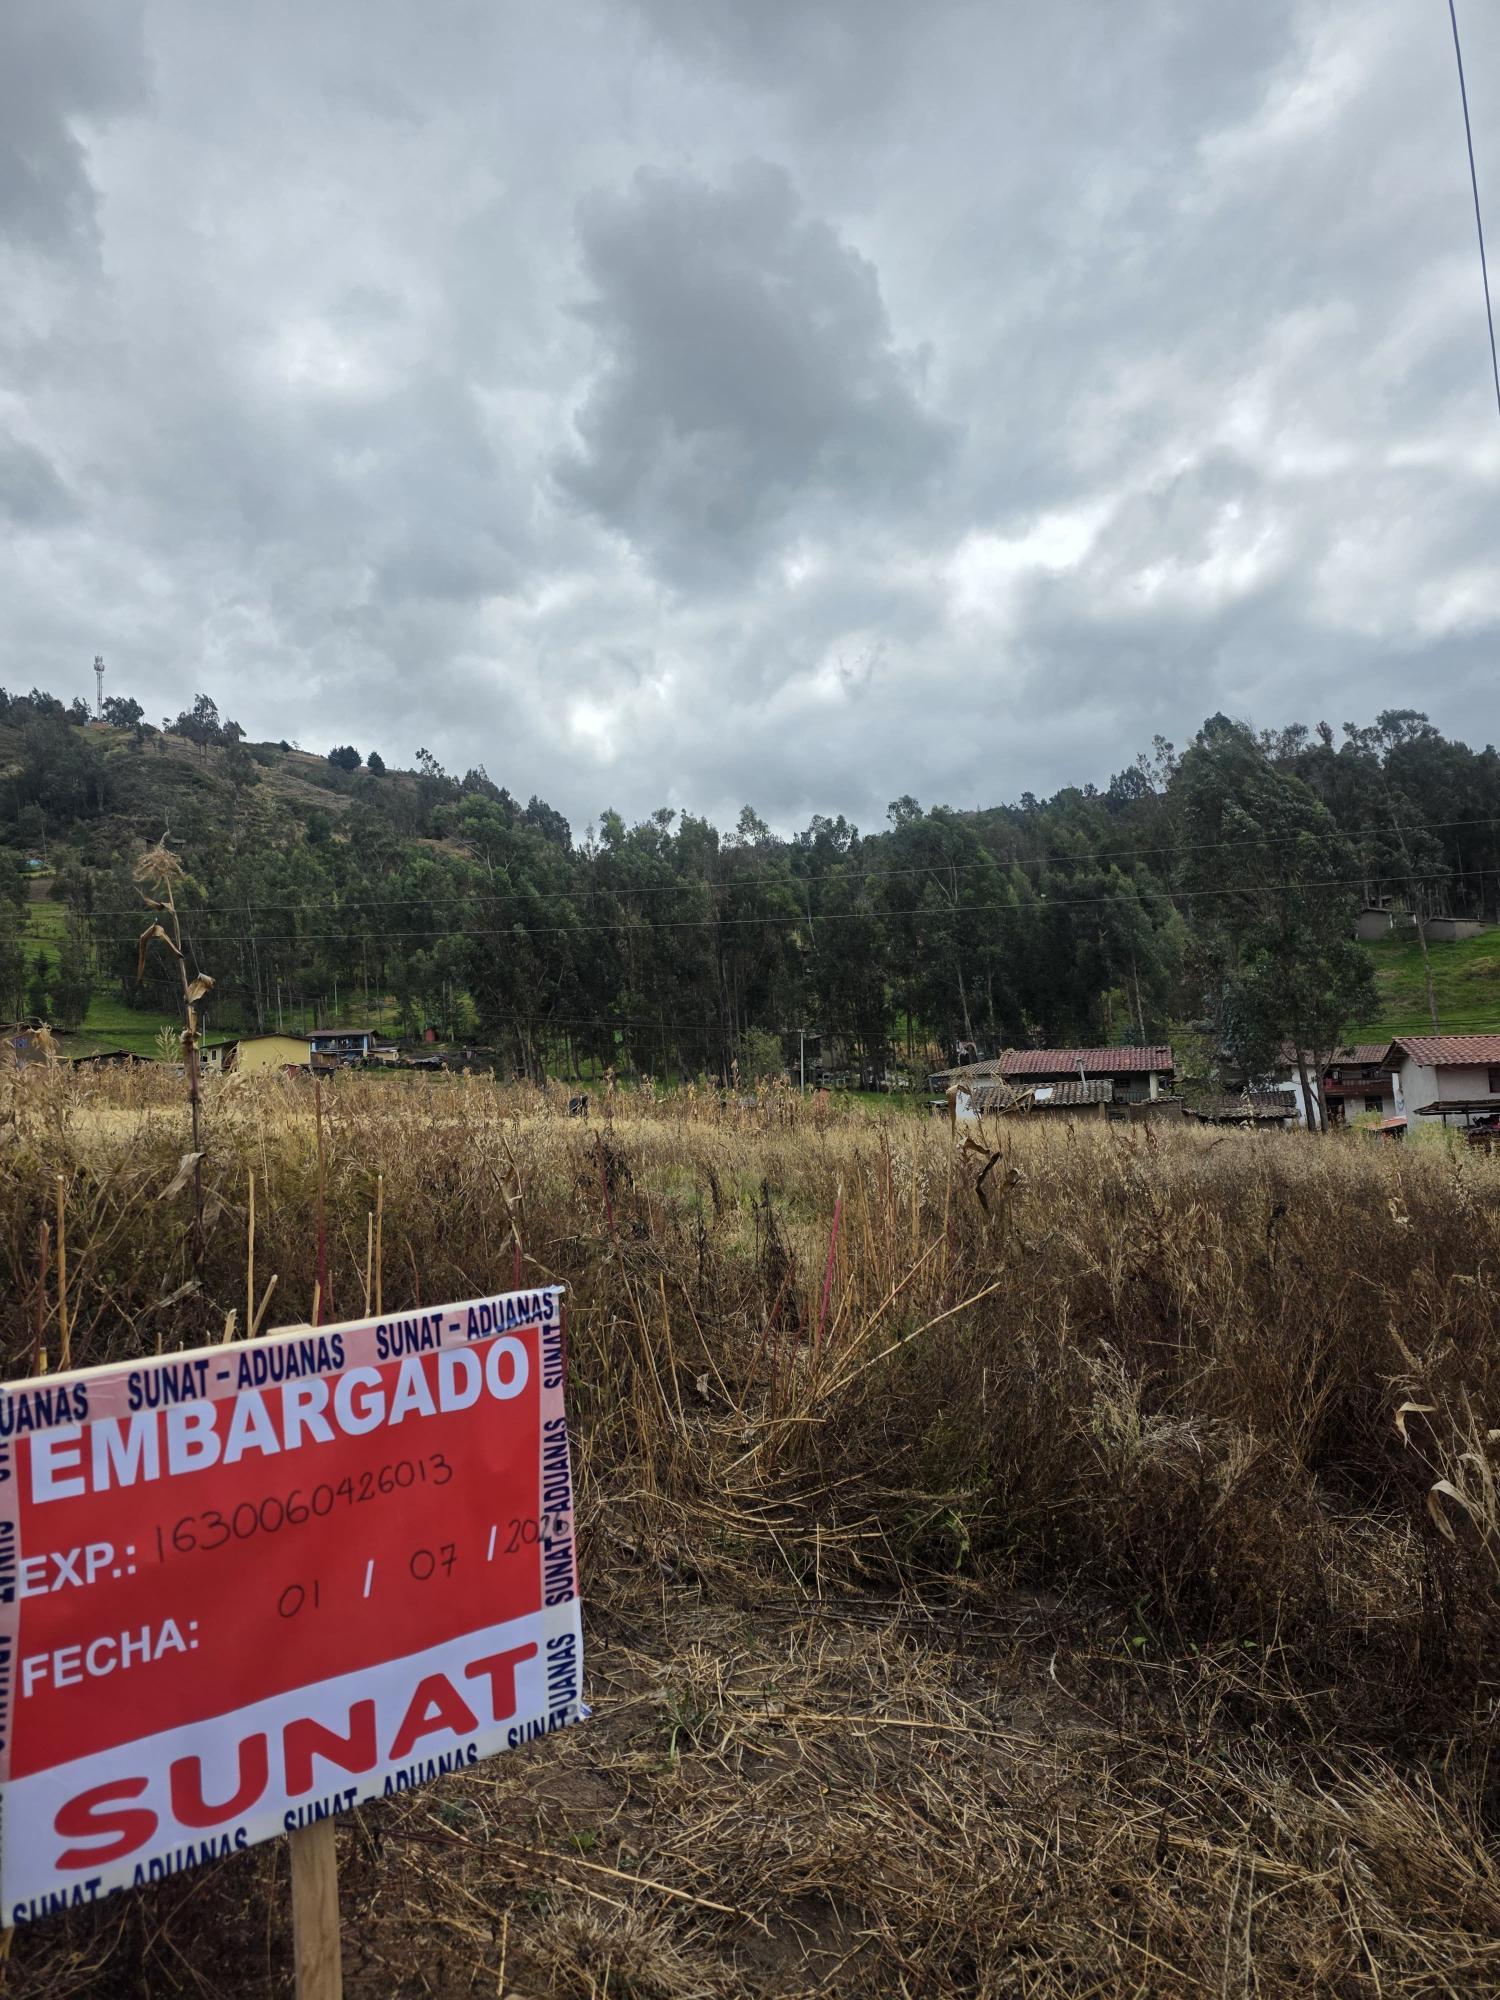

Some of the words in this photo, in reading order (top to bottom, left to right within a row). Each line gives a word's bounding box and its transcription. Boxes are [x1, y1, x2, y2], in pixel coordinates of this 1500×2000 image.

[375, 1313, 443, 1360] SUNAT
[467, 1292, 554, 1341] ADUANAS
[127, 1360, 209, 1411] SUNAT
[237, 1333, 345, 1389] ADUANAS
[30, 1336, 530, 1504] EMBARGADO
[543, 1416, 571, 1514] ADUANAS
[19, 1543, 137, 1598] EXP.:
[544, 1537, 575, 1608] SUNAT
[22, 1618, 200, 1698] FECHA:
[54, 1641, 539, 1870] SUNAT
